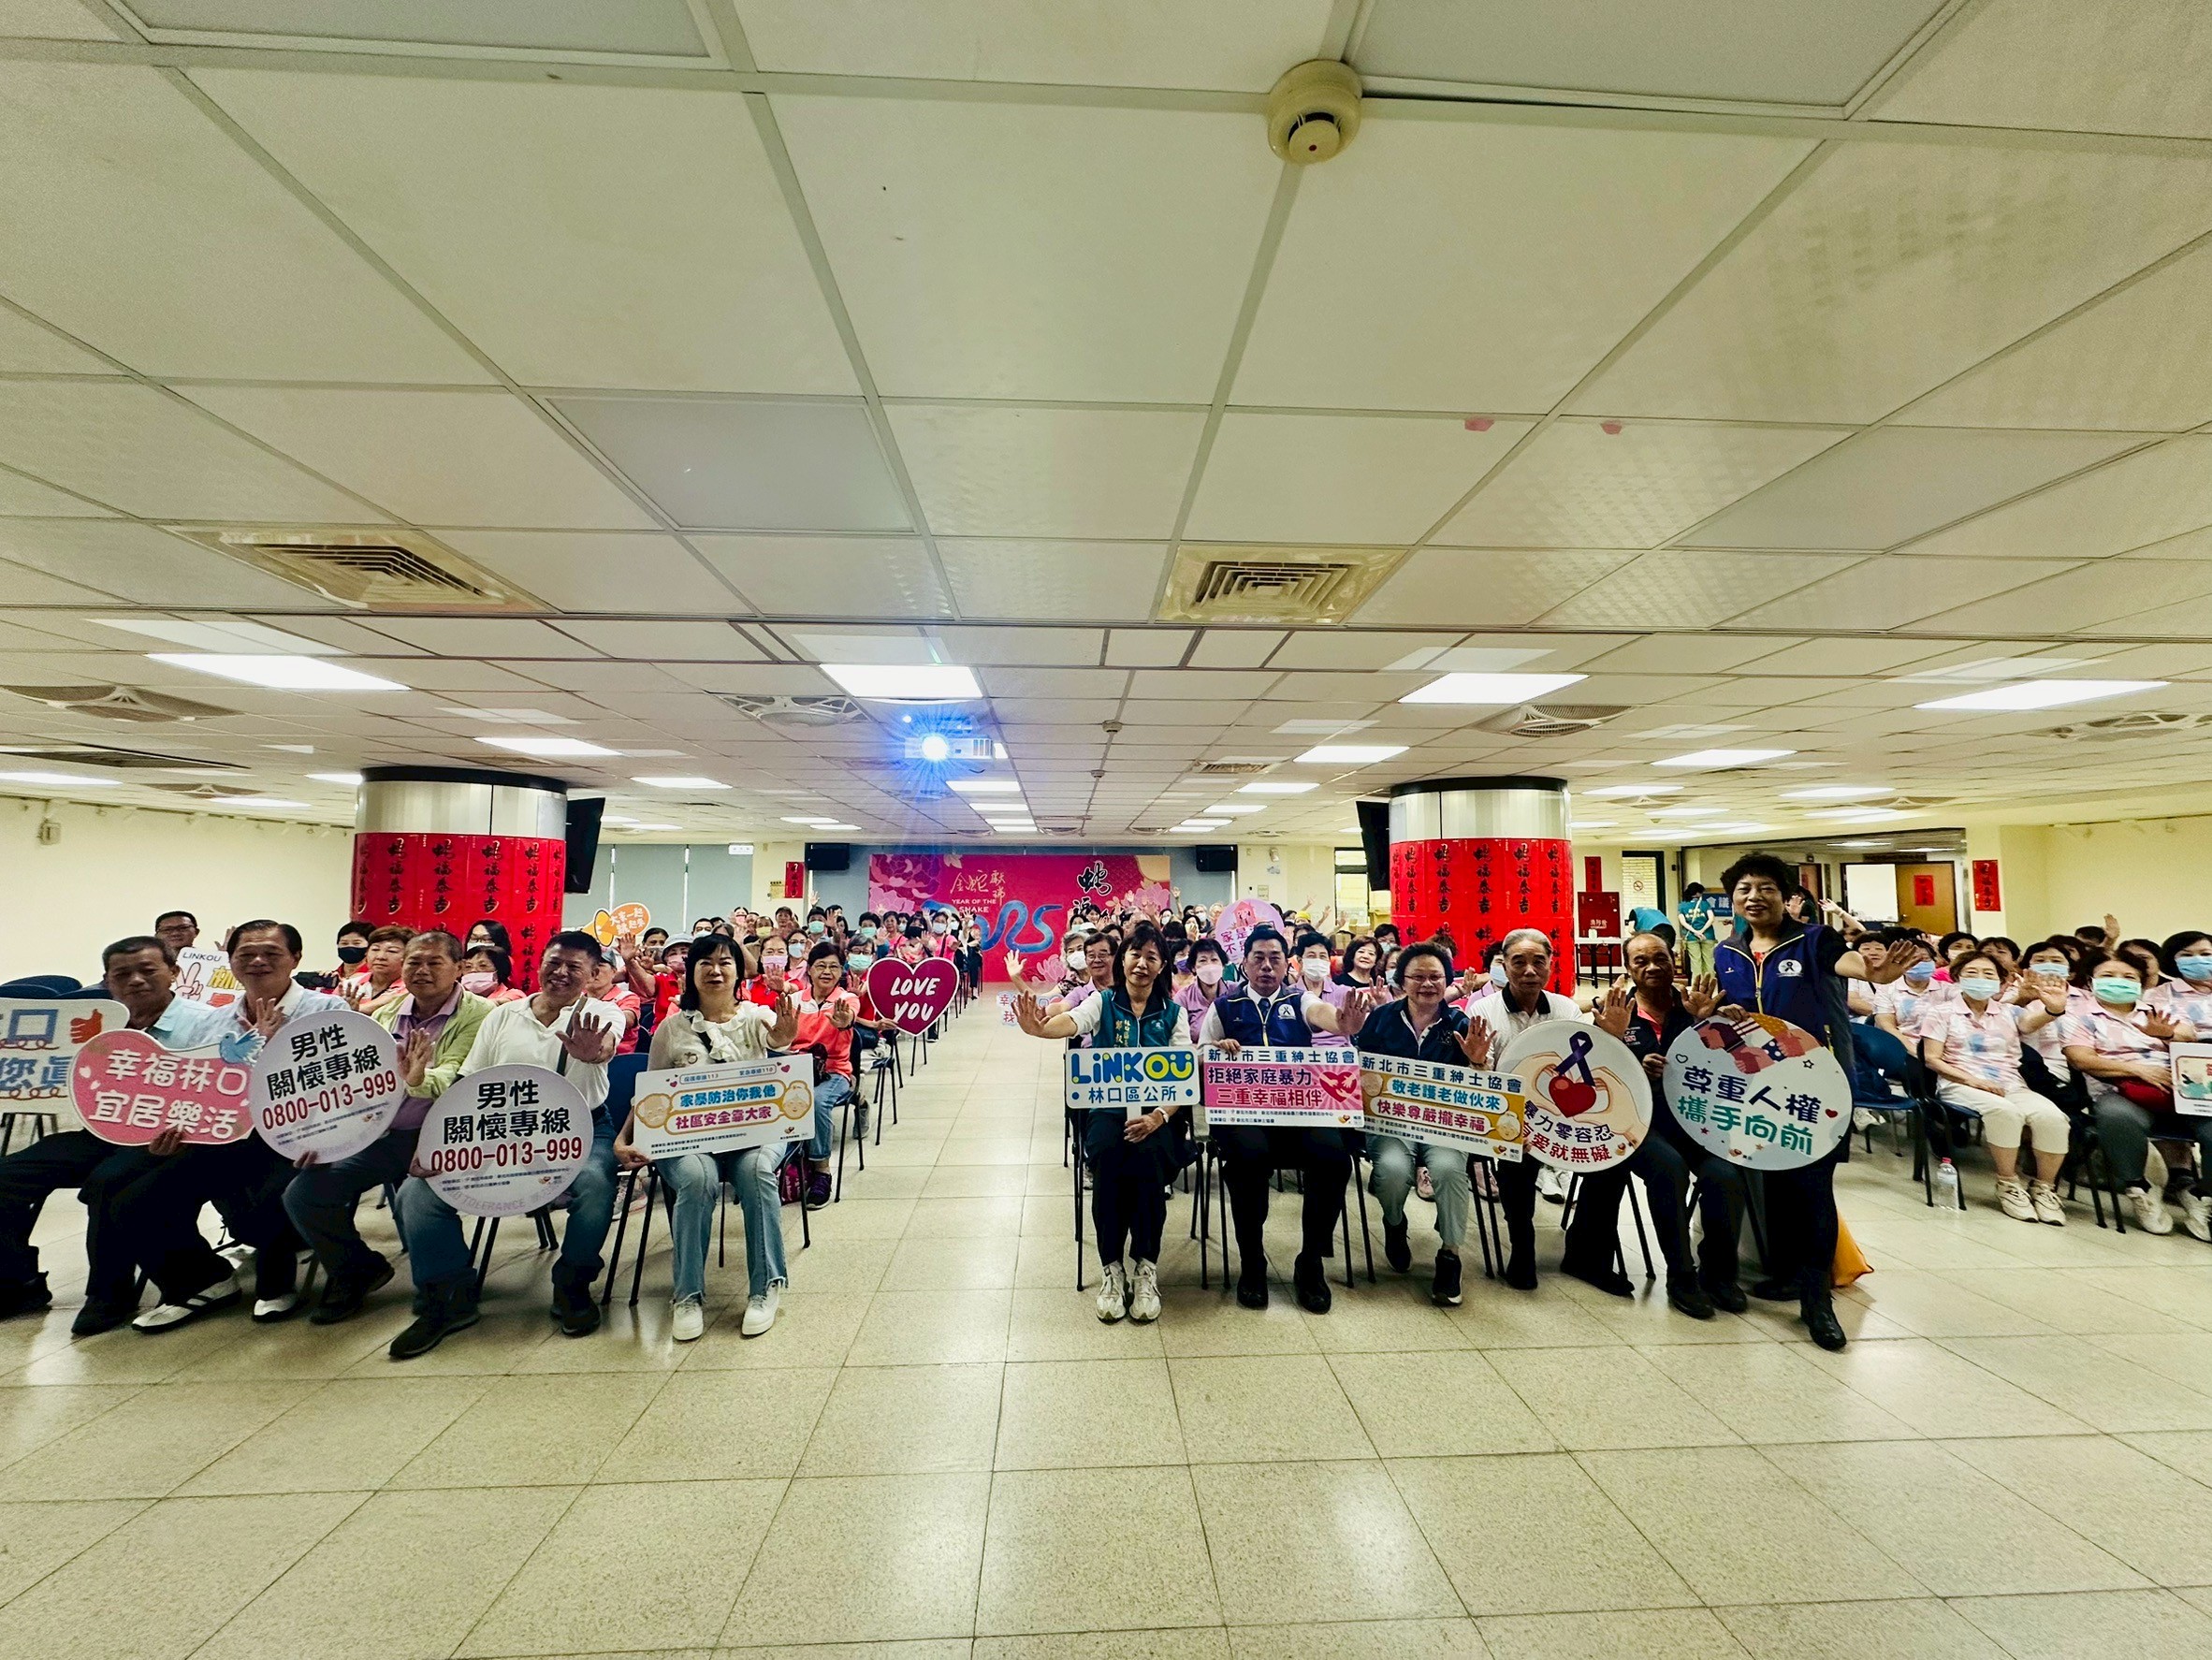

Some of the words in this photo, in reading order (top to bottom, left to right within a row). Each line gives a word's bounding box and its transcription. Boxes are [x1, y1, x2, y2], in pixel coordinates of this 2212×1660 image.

[1221, 925, 1254, 943] 家是
[182, 952, 222, 962] LINKOU
[890, 975, 941, 997] LOVE
[894, 1000, 935, 1024] YOU
[290, 1025, 348, 1063] 男性
[1208, 1049, 1356, 1064] 新北市三重紳士協會
[107, 1048, 249, 1097] 幸福林口
[266, 1043, 383, 1102] 關懷專線
[1208, 1067, 1313, 1086] 拒絕家庭暴力
[1361, 1055, 1522, 1094] 新北市三重紳士協會
[262, 1070, 397, 1130] 0800-013-999
[477, 1079, 540, 1110] 男性
[679, 1083, 777, 1108] 家暴防治你我他
[1088, 1085, 1177, 1104] 林口區公所
[1217, 1088, 1323, 1107] 三重幸福相伴
[1391, 1078, 1501, 1112] 敬老護老做伙來
[1681, 1065, 1823, 1124] 尊重人權
[88, 1089, 239, 1141] 宜居樂活
[443, 1107, 572, 1145] 關懷專線
[675, 1104, 772, 1130] 社區安全靠大家
[1376, 1099, 1486, 1133] 快樂尊嚴攏幸福
[1524, 1099, 1615, 1143] 暴力零容忍
[1677, 1095, 1814, 1157] 攜手向前
[430, 1136, 583, 1173] 0800-013-999
